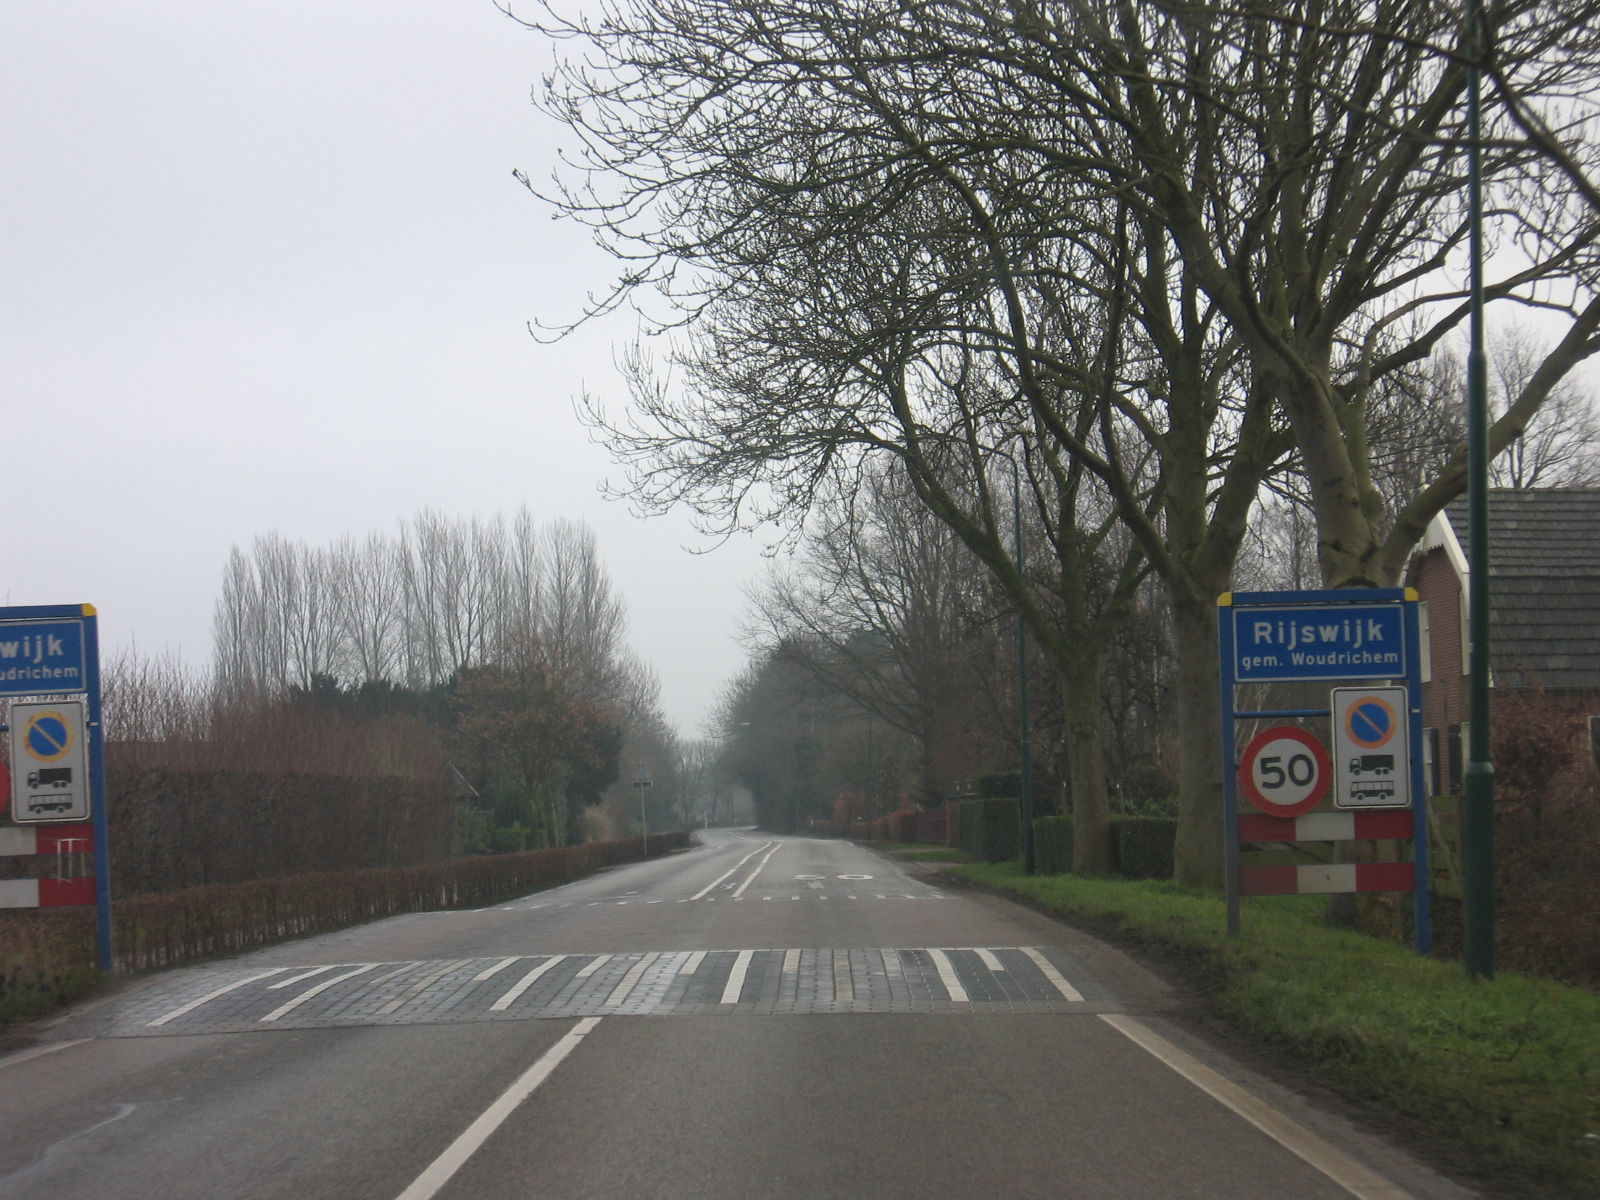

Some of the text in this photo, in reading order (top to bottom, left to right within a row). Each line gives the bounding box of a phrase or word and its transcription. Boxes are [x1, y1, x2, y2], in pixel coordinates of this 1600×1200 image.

[1254, 619, 1383, 650] Rijswijk
[1242, 650, 1399, 671] gem. Woudrichem
[1260, 754, 1315, 789] 50
